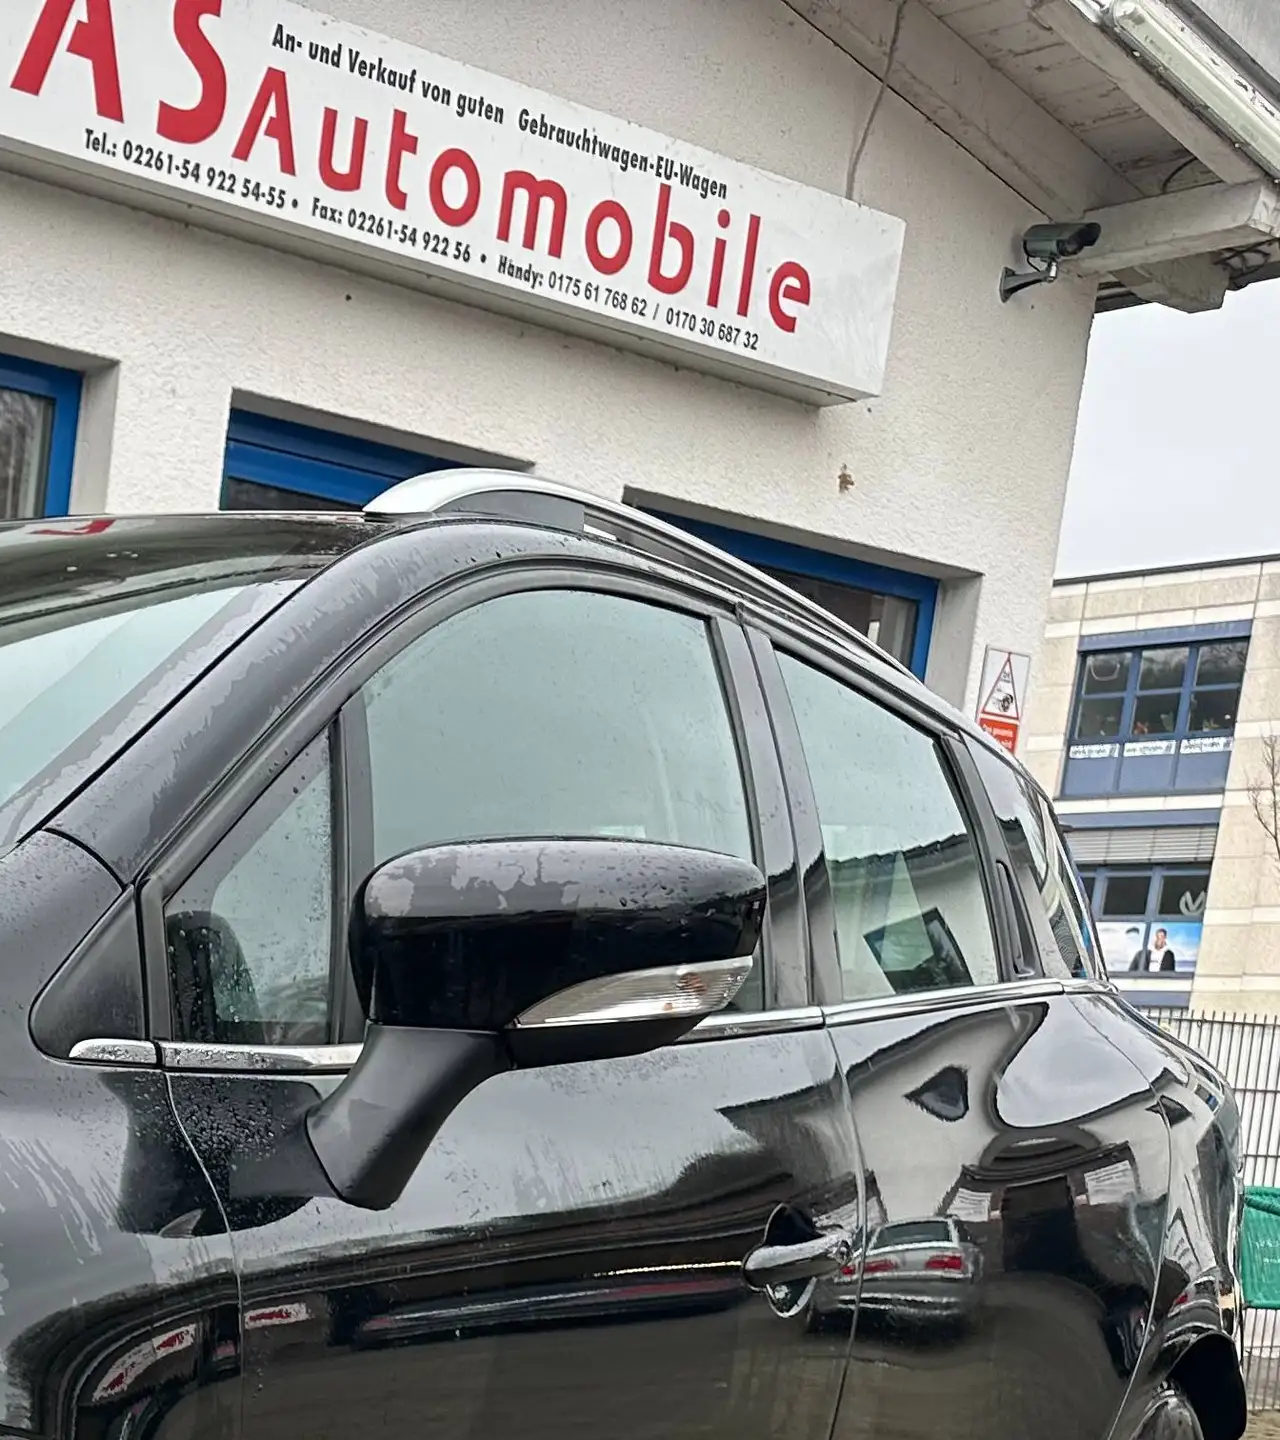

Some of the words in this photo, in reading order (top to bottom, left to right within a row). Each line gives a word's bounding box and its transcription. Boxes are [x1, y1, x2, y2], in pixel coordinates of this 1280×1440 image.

[272, 23, 303, 53] An-
[308, 43, 342, 68] und
[348, 48, 417, 94] Verkauf
[421, 80, 452, 107] von
[455, 93, 505, 125] guten
[518, 108, 728, 200] Gebrauchtwagen-EU-Wagen
[84, 128, 118, 157] Tel.:
[122, 140, 201, 184] 02261-54
[206, 167, 237, 194] 922
[240, 178, 287, 210] 54-55
[311, 197, 343, 224] Fax:
[346, 208, 419, 248] 02261-54
[422, 231, 450, 258] 922
[453, 241, 472, 264] 56
[496, 254, 545, 291] Handy:
[547, 270, 581, 297] 0175
[583, 281, 601, 303] 61
[603, 287, 629, 311] 768
[630, 296, 648, 317] 62
[665, 306, 697, 332] 0170
[698, 317, 716, 338] 30
[717, 322, 742, 346] 687
[742, 332, 760, 352] 32
